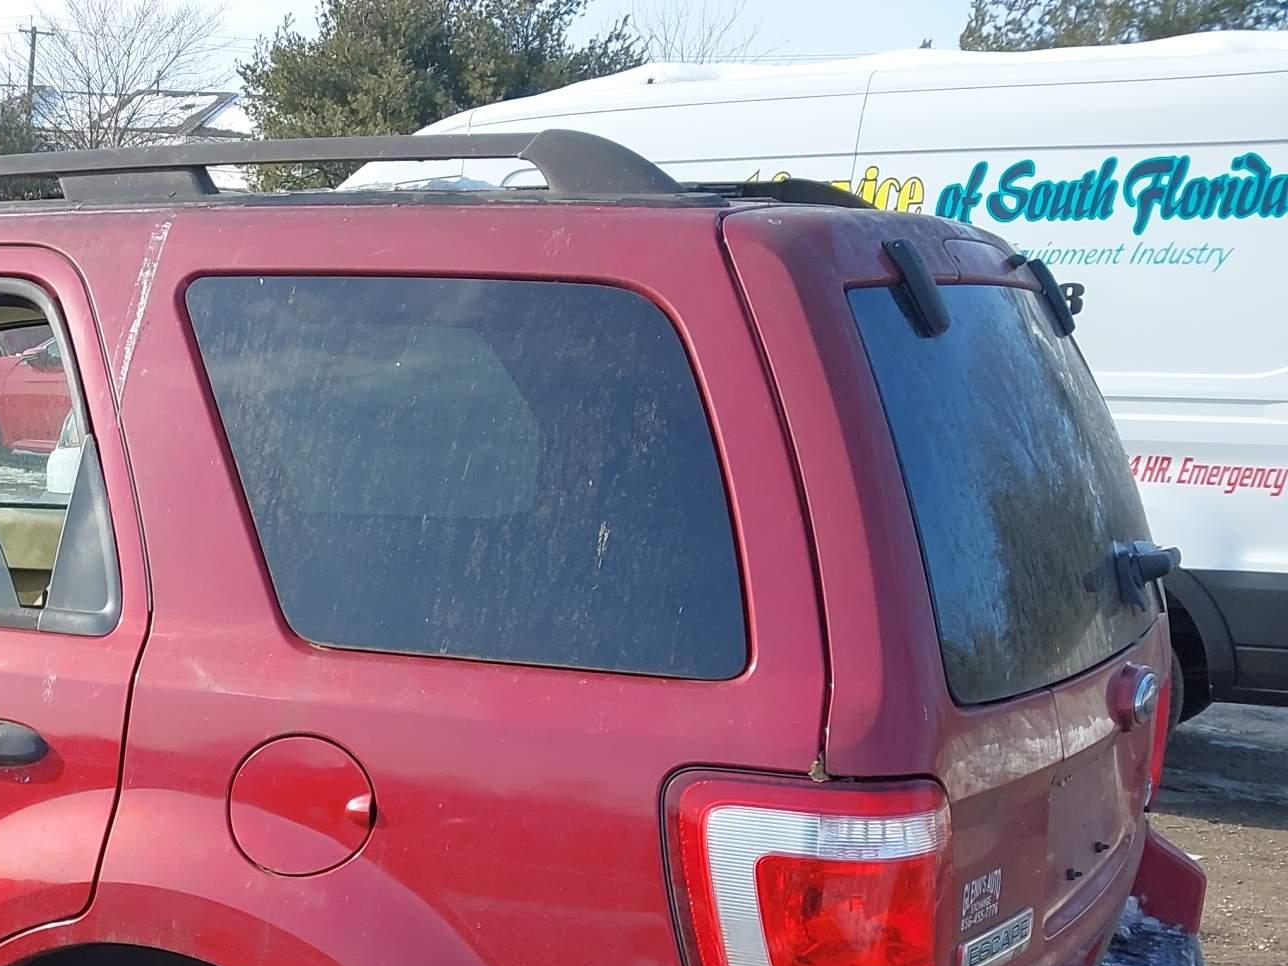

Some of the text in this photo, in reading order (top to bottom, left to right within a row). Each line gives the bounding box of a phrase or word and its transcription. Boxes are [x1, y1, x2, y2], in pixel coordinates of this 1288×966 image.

[935, 161, 988, 223] of
[986, 159, 1118, 223] South
[1123, 152, 1288, 235] Florida
[1129, 241, 1235, 272] Industry
[1141, 456, 1172, 483] HR.
[1176, 457, 1288, 496] Emergency
[987, 868, 1002, 901] AUTO
[969, 918, 1030, 966] ESCAPE
